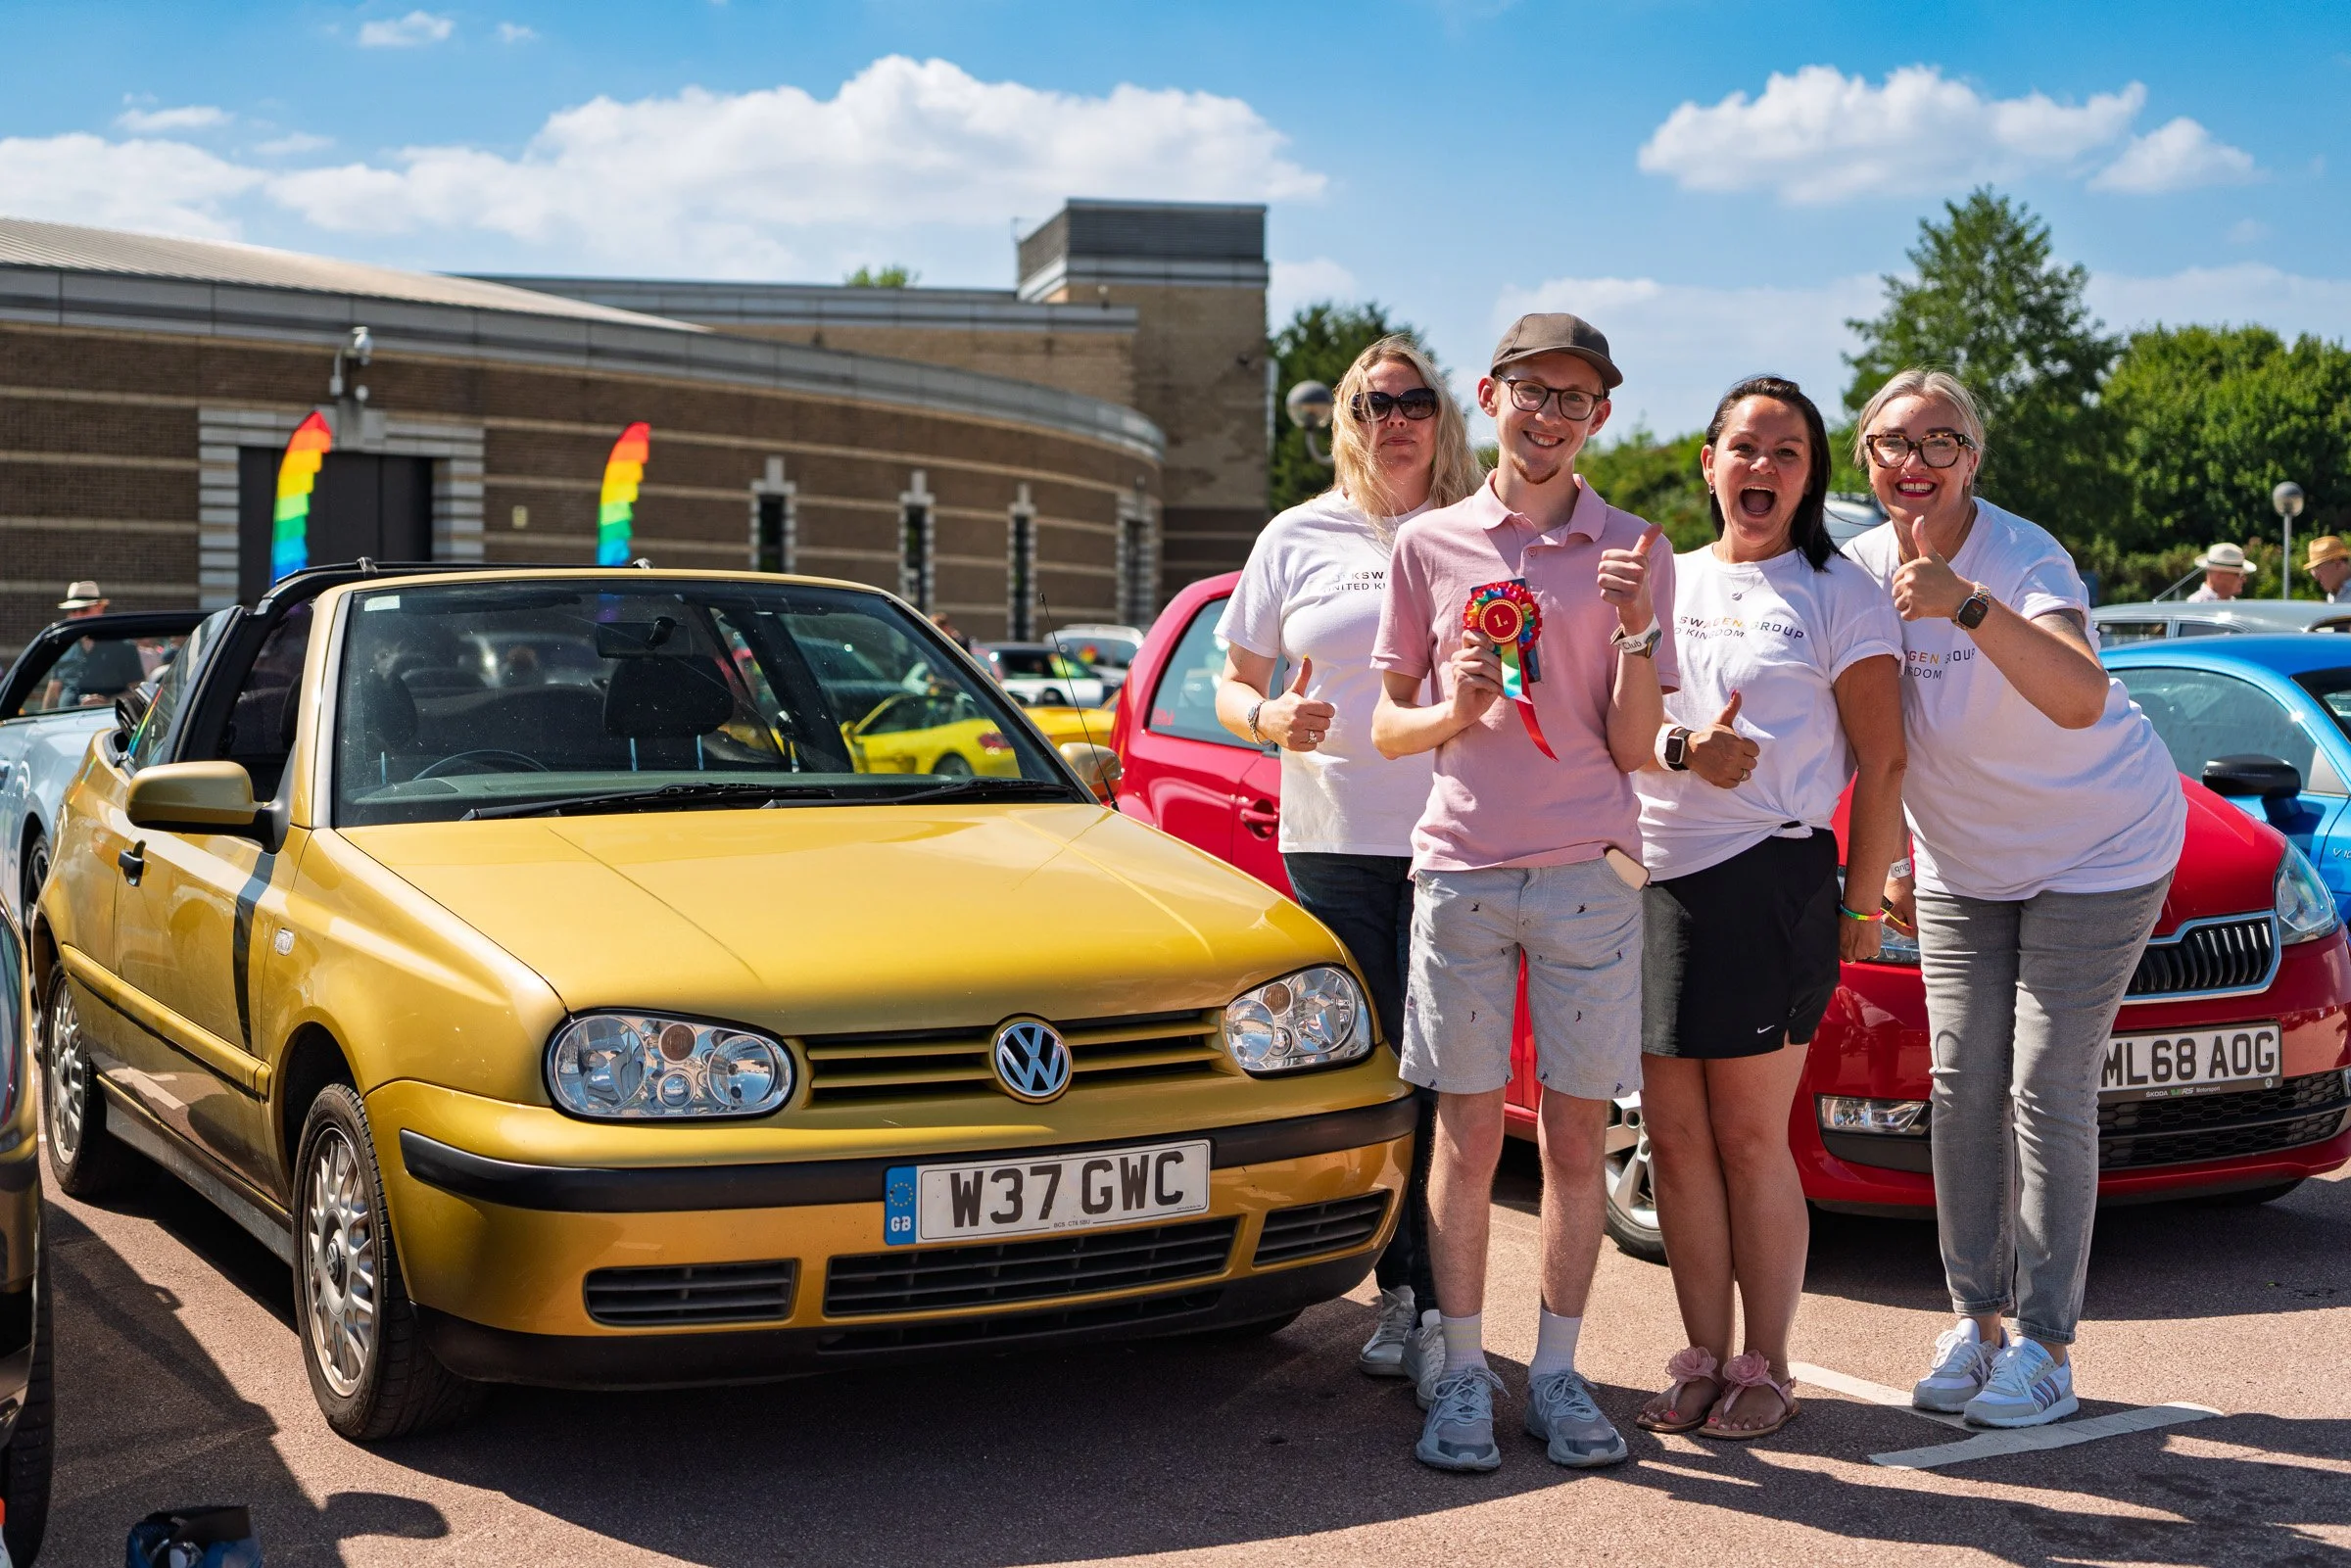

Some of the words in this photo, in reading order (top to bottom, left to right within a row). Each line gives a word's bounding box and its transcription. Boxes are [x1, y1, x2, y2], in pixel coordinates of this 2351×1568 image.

[2101, 1039, 2196, 1087] ML68
[2209, 1031, 2275, 1078] AOG
[950, 1164, 1062, 1228] W37
[1081, 1151, 1184, 1214] GWC
[890, 1215, 911, 1232] GB
